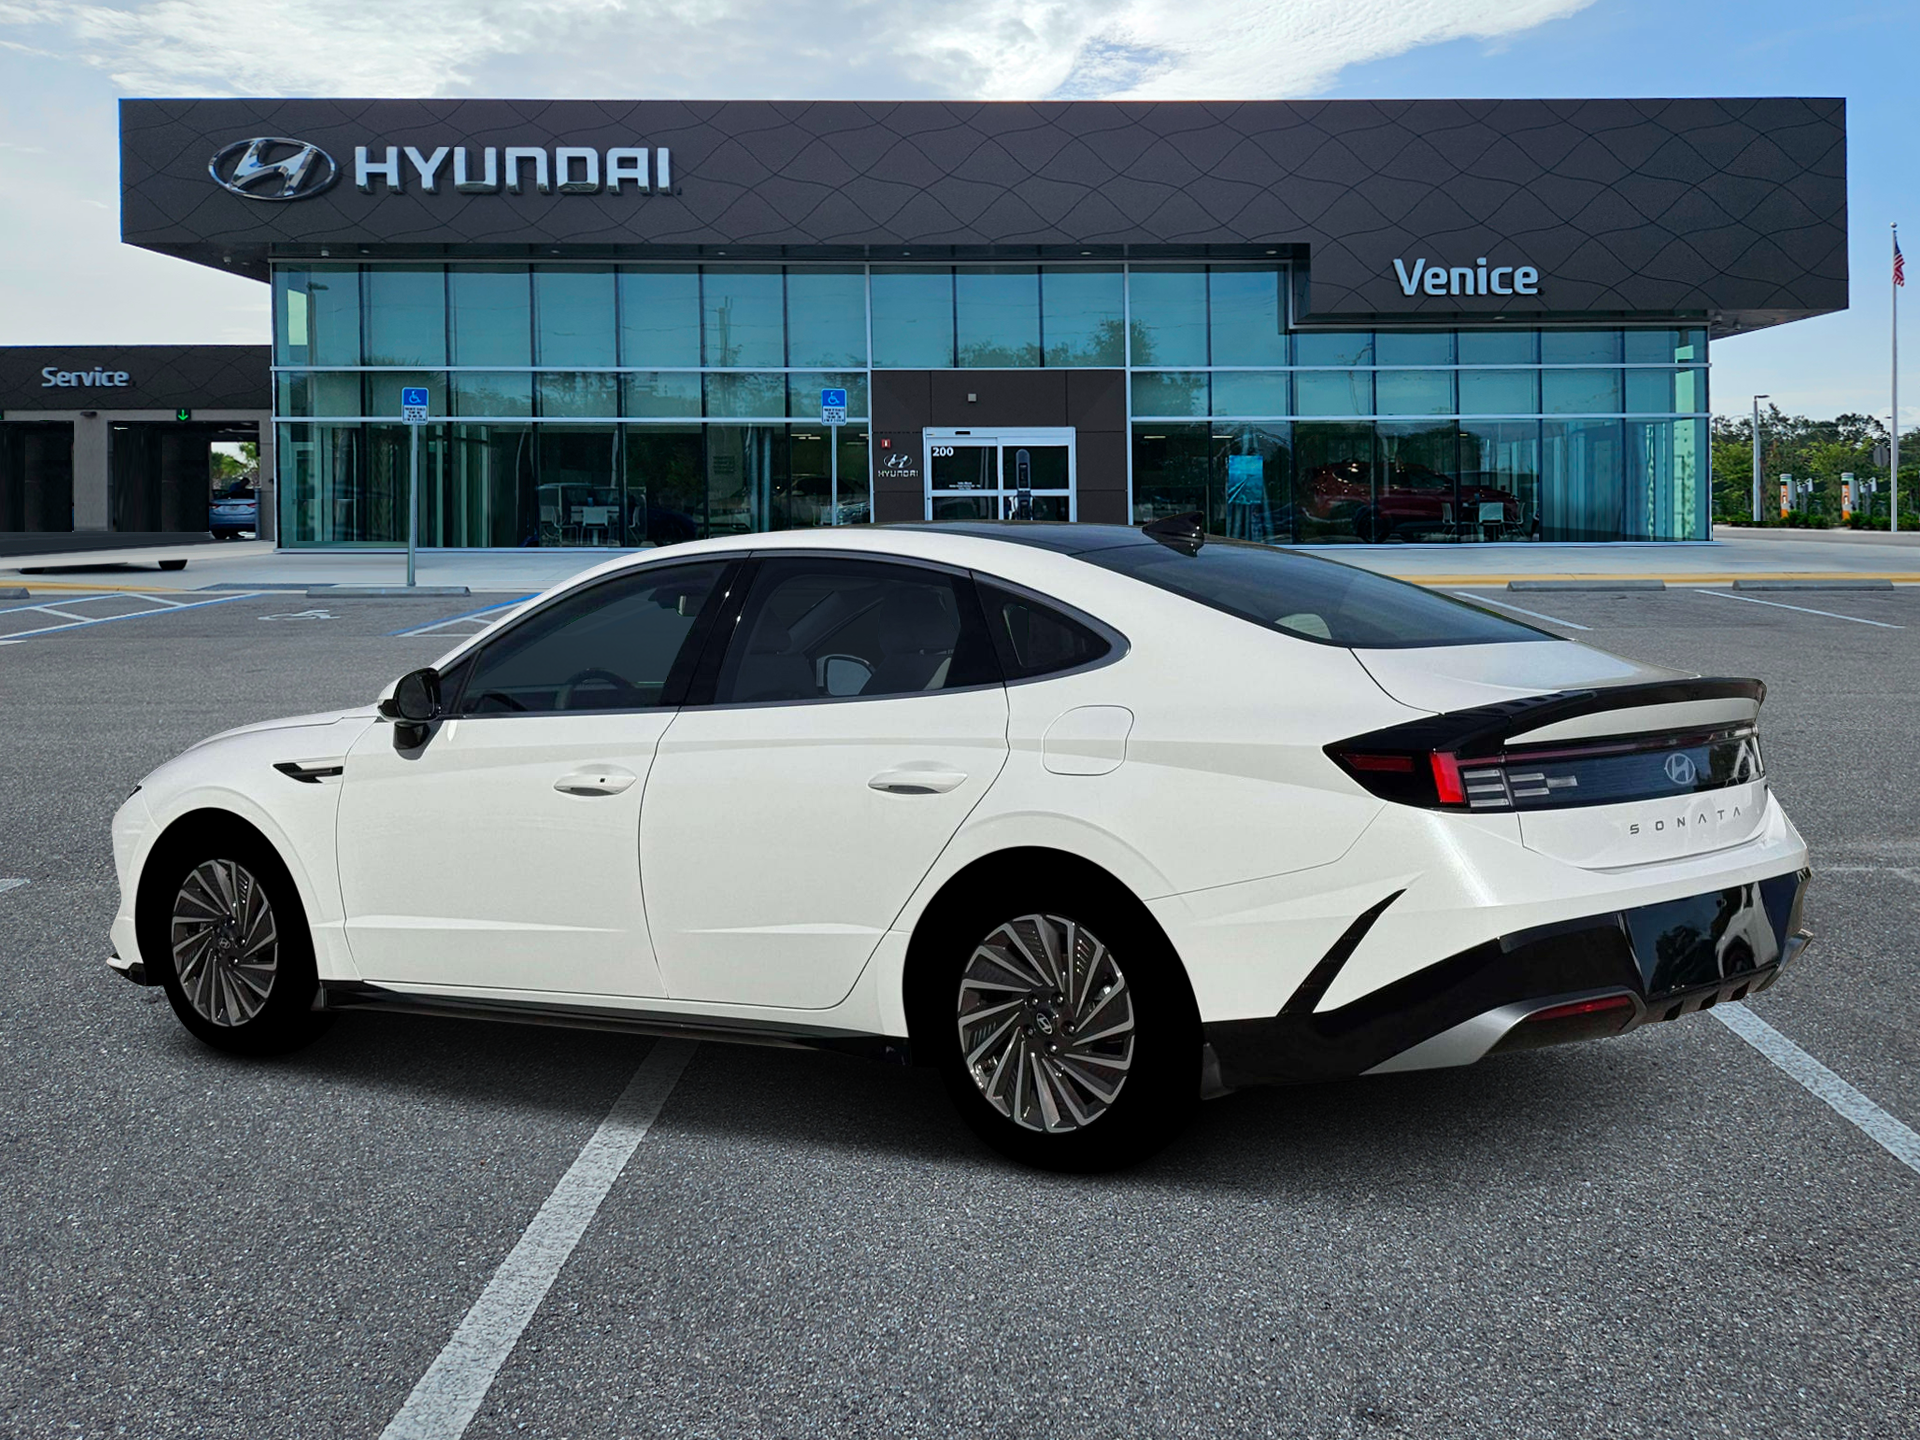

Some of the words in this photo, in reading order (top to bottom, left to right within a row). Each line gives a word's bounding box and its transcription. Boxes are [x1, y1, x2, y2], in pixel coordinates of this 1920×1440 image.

[353, 145, 671, 196] HYUNDAI
[1392, 256, 1540, 297] Venice
[41, 366, 130, 388] Service
[932, 446, 954, 457] 200
[877, 469, 919, 478] HYUNDAI
[1629, 806, 1741, 835] SONATA
